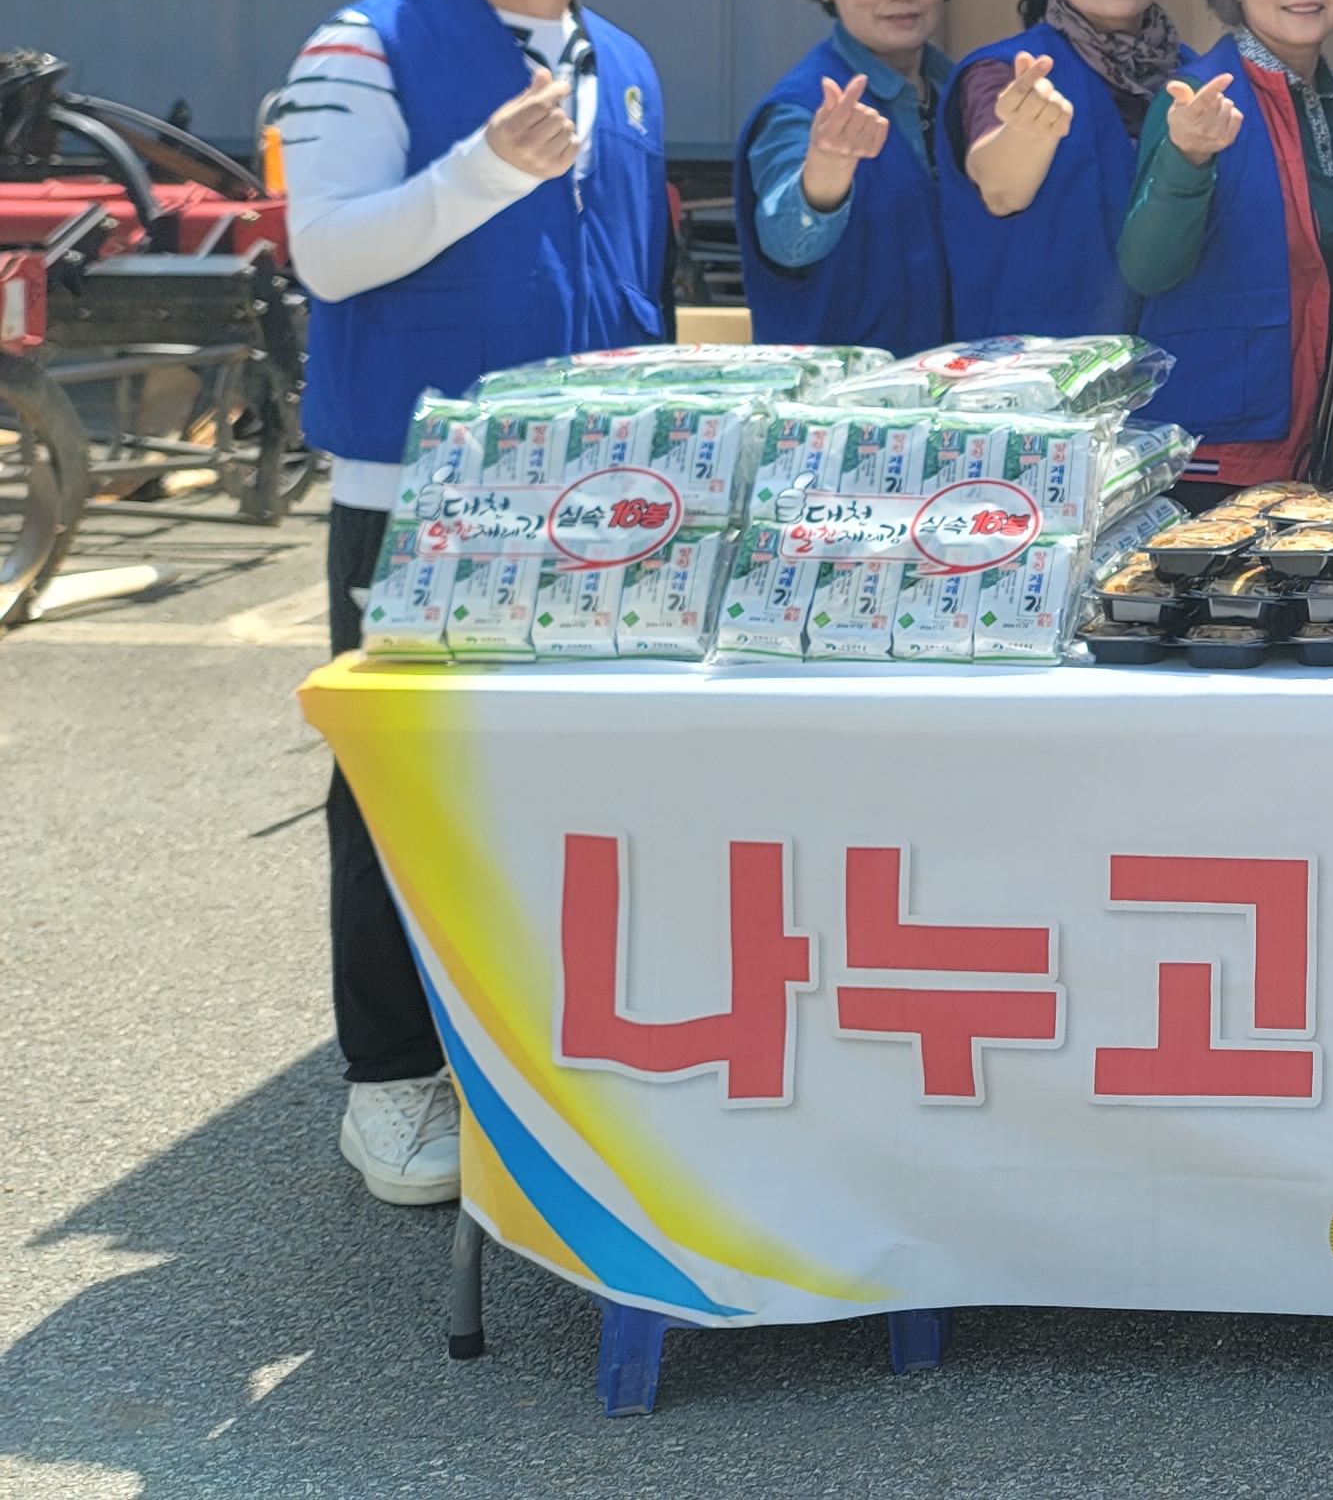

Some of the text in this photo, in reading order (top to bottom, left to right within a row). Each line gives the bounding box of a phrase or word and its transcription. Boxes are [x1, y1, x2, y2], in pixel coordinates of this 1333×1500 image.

[443, 493, 512, 519] 대천
[557, 498, 673, 529] 실속 16봉
[805, 498, 873, 524] 대천
[920, 509, 1032, 537] 실속 16봉
